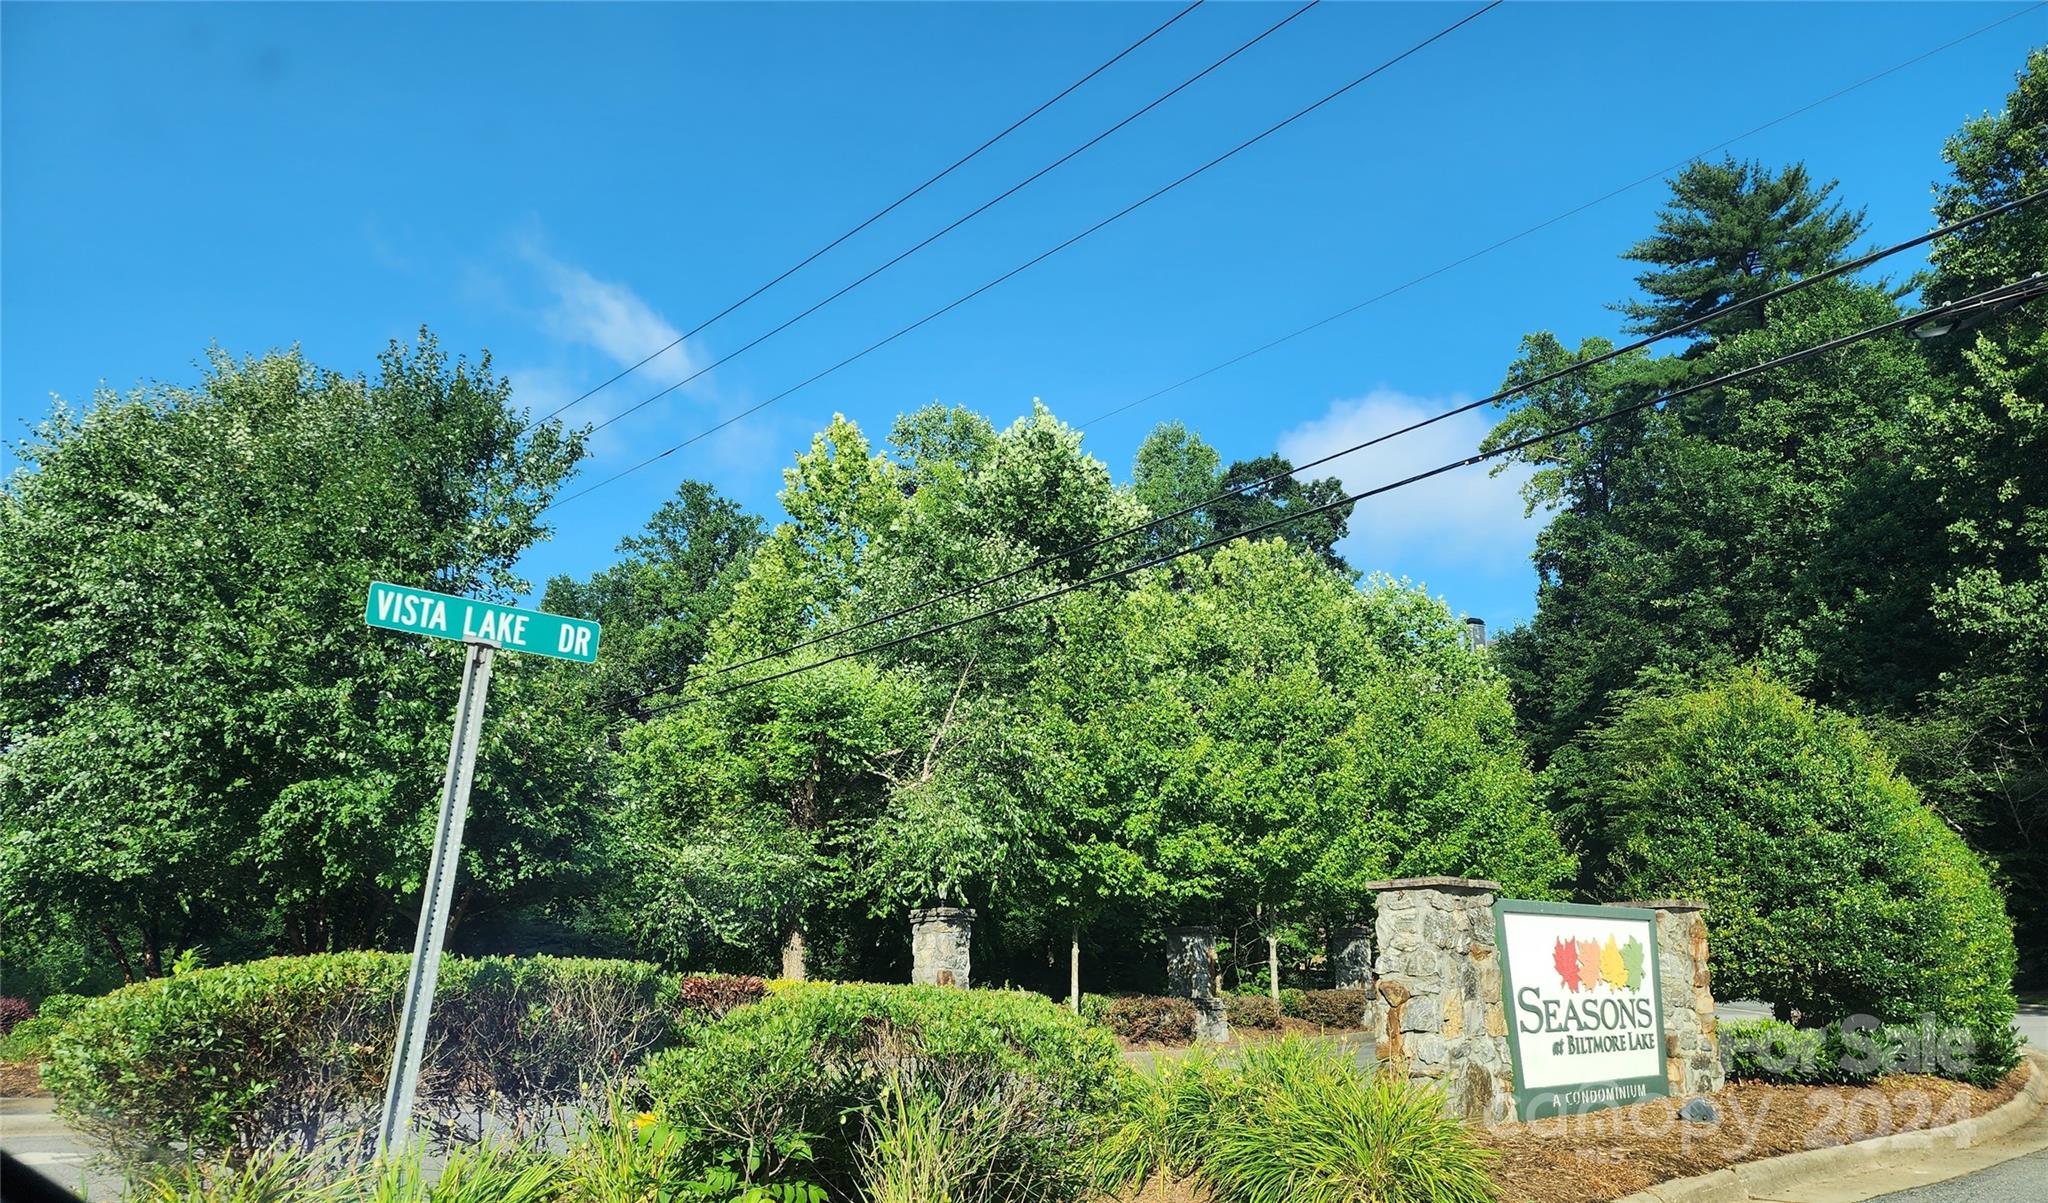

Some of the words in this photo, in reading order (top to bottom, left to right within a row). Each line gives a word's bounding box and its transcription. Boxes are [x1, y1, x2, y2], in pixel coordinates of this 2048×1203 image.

[378, 589, 447, 631] VISTA
[463, 606, 530, 646] LAKE
[558, 623, 592, 657] DR
[1517, 986, 1653, 1034] SEASONS
[1552, 1038, 1565, 1056] at
[1566, 1035, 1627, 1055] BILTMORE
[1627, 1032, 1656, 1051] LAKE
[1552, 1094, 1561, 1107] A
[1565, 1084, 1647, 1106] CONDOMINIUM
